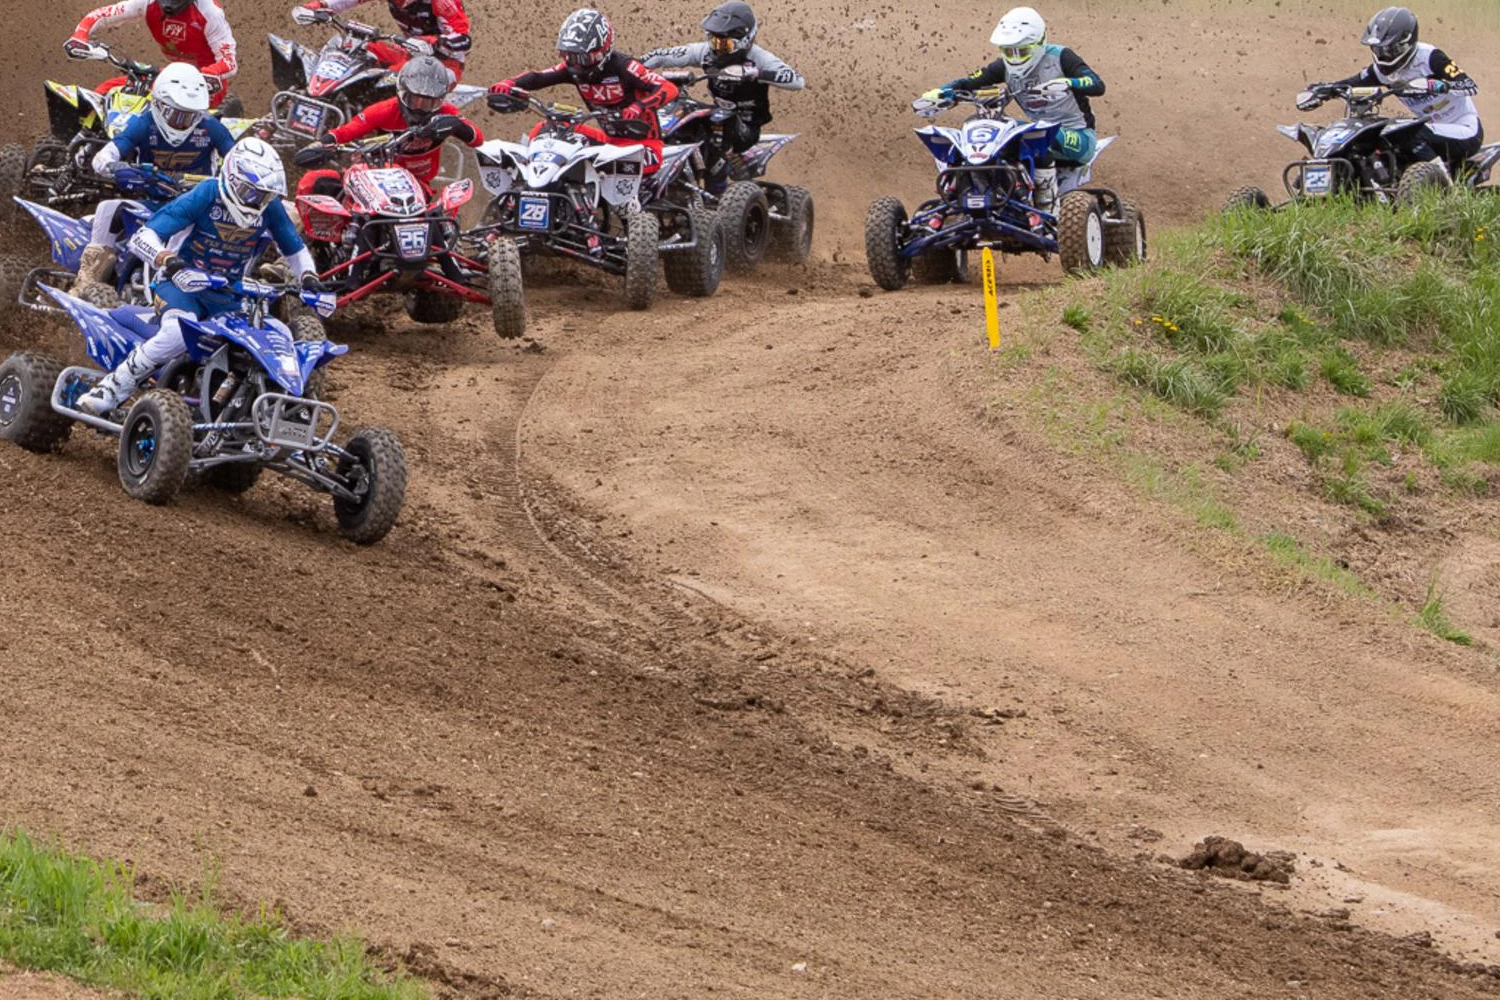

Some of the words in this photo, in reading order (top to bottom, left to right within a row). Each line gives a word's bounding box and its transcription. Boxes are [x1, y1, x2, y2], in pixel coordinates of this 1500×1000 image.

[967, 197, 985, 209] 5
[521, 204, 547, 221] 28
[401, 231, 425, 250] 26
